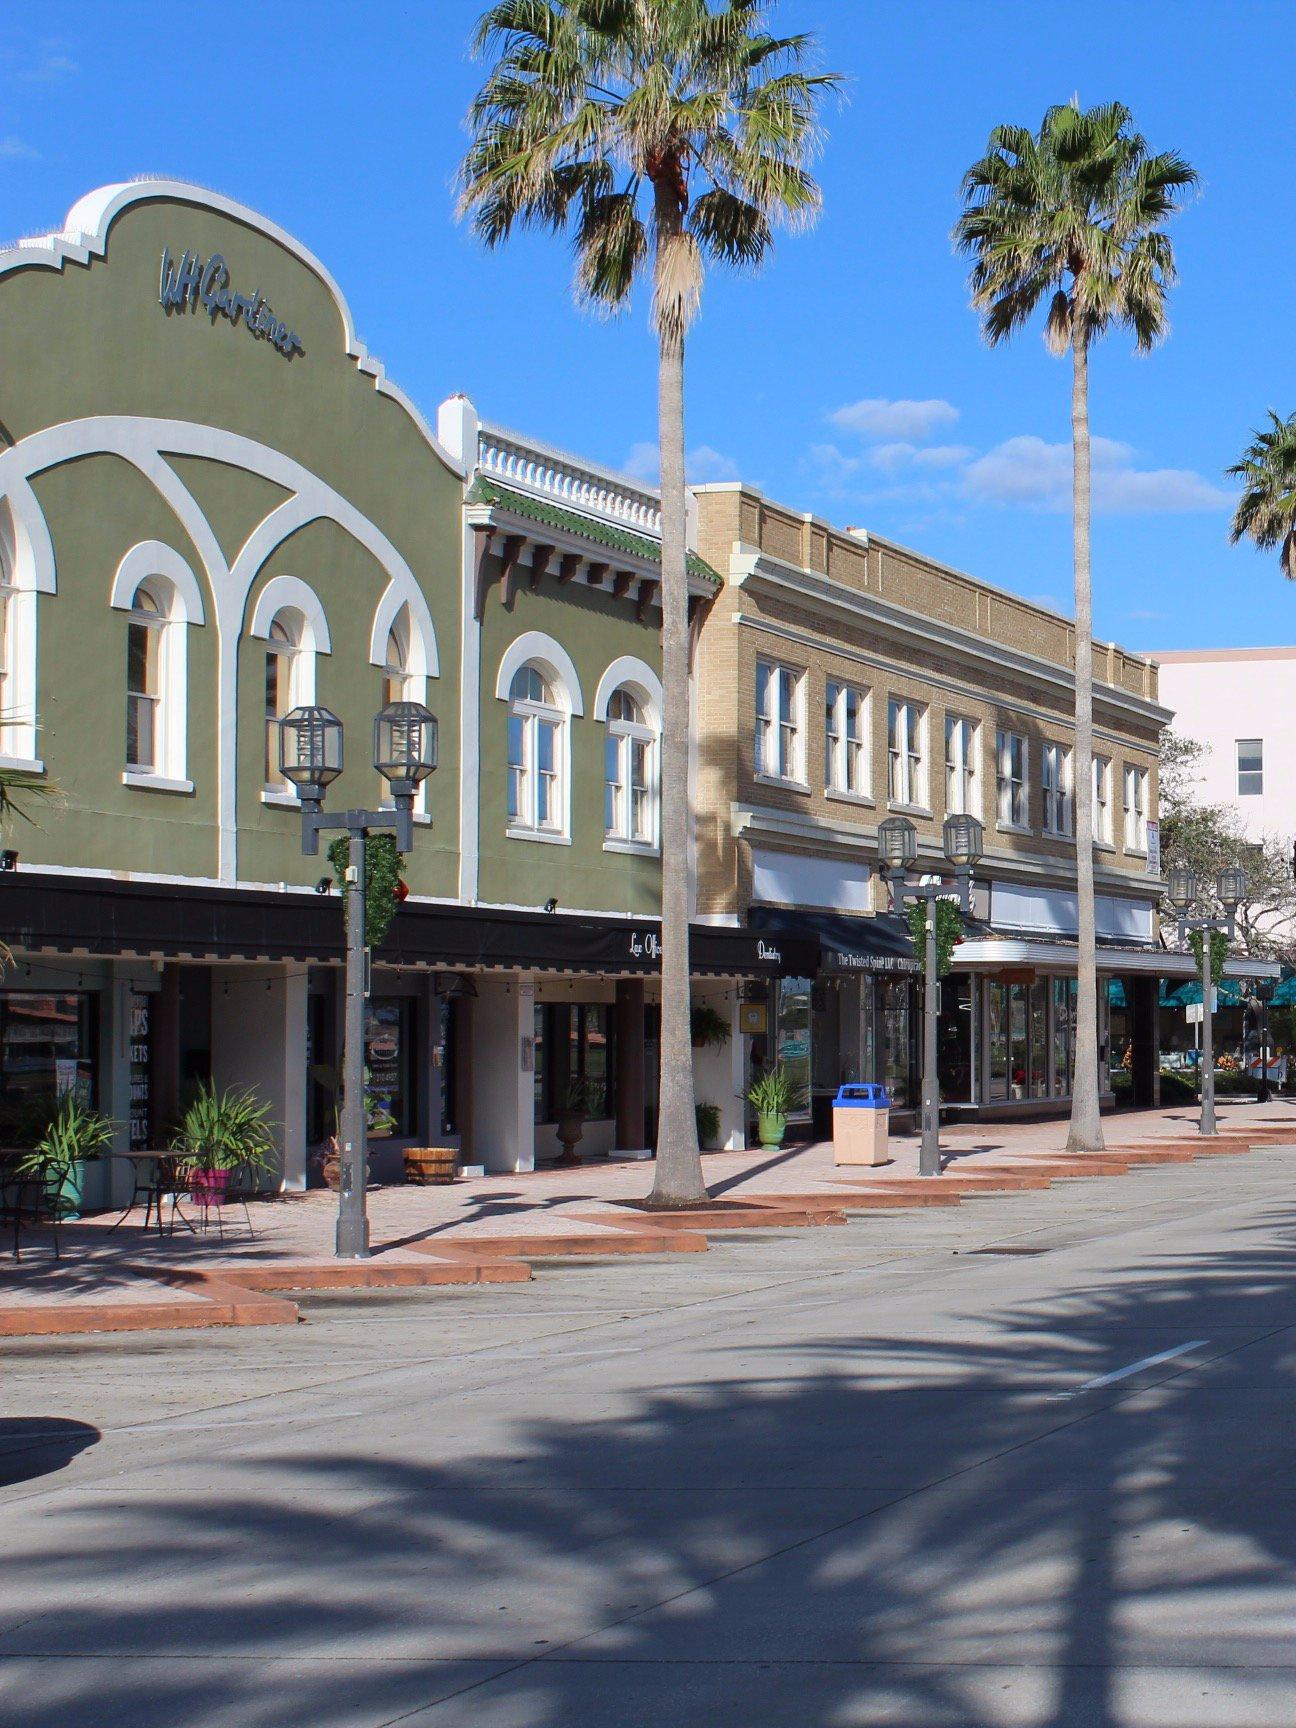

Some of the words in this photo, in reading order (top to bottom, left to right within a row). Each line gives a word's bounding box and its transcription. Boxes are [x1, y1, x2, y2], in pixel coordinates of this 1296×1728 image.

[757, 939, 781, 964] Dentistry
[837, 953, 848, 966] The
[848, 954, 869, 968] Twisted
